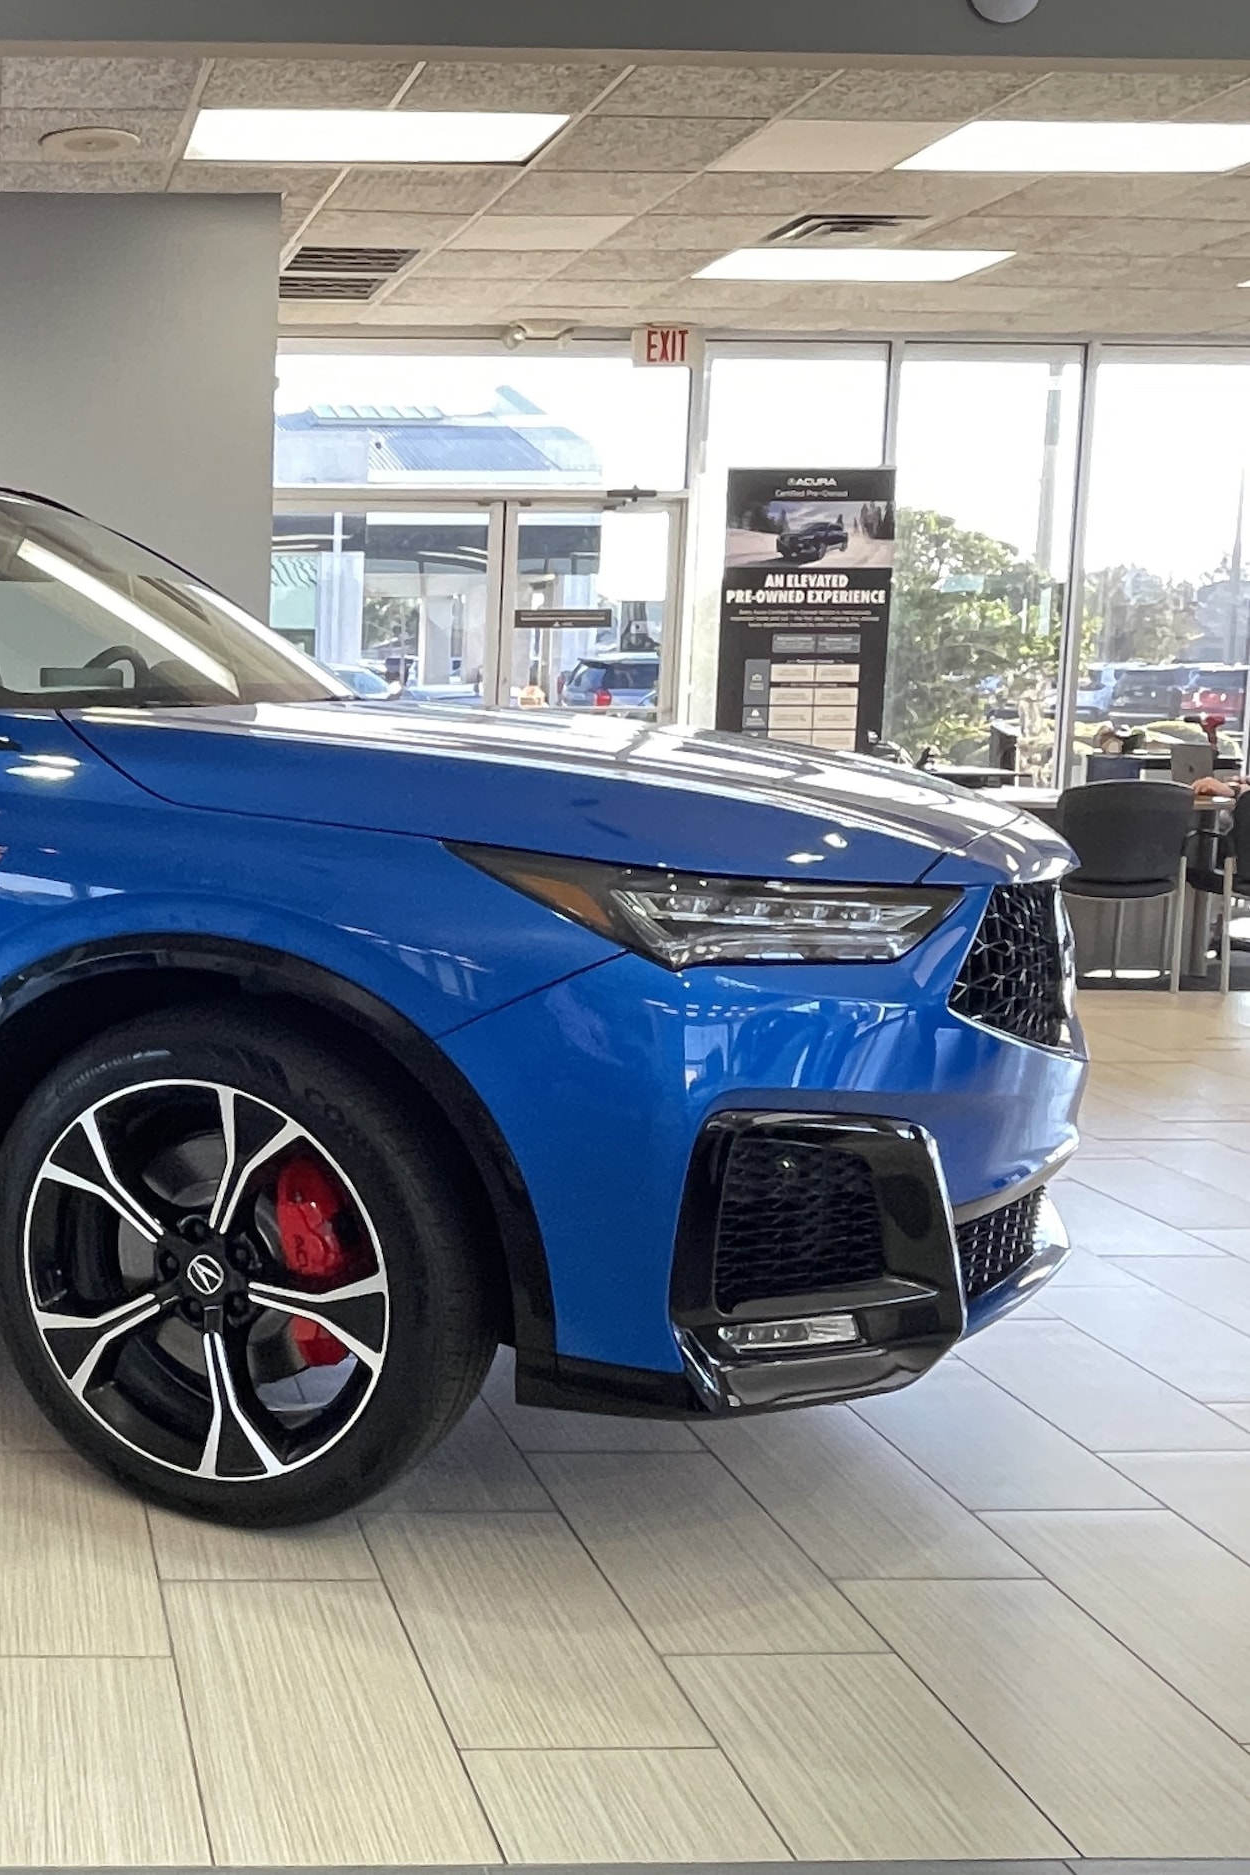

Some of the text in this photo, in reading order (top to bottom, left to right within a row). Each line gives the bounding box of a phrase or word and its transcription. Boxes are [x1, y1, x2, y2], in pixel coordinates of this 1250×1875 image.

[647, 330, 689, 362] EXIT
[796, 477, 838, 487] ACURA
[764, 574, 849, 588] AN ELEVATED
[725, 589, 886, 604] PRE-OWNED EXPERIENCE
